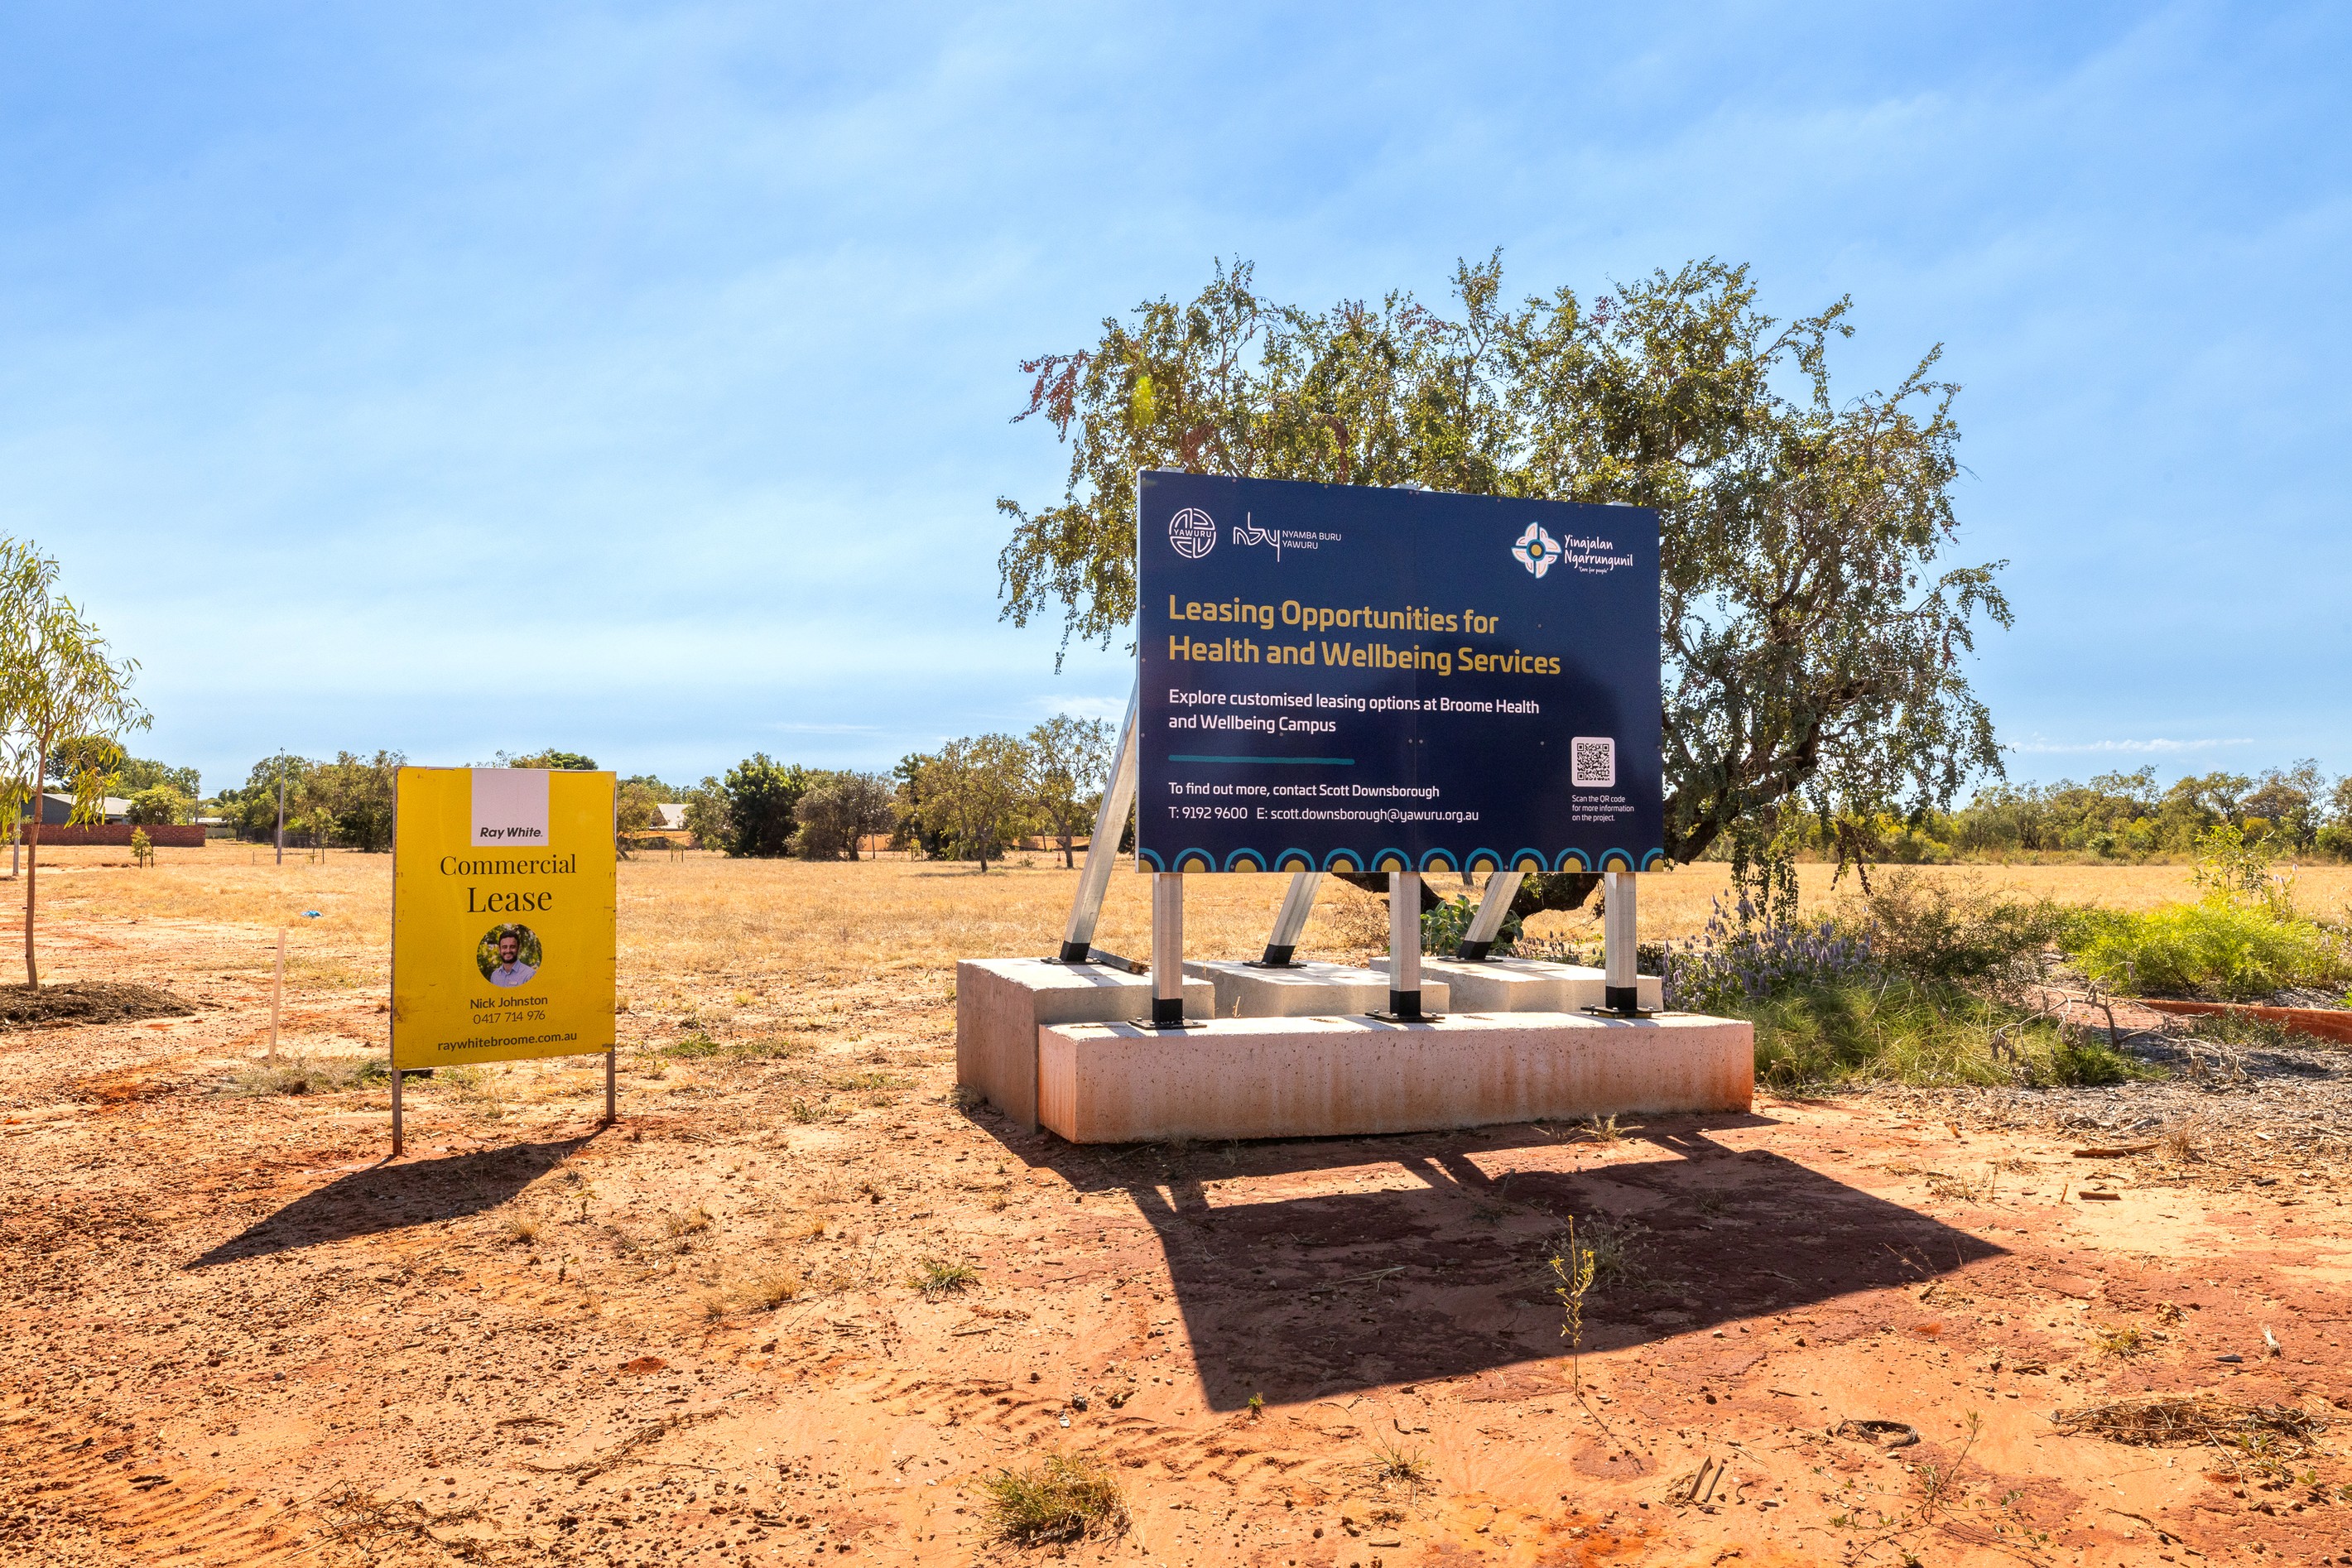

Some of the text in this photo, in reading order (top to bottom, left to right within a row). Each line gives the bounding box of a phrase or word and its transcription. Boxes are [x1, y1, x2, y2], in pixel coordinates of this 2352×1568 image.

[1174, 529, 1212, 538] YAWURU
[1282, 531, 1341, 541] NYAMBA BURU
[1282, 540, 1318, 549] YAWURU
[1565, 535, 1613, 555] Yinajalan
[1565, 549, 1633, 570] Ngarrungunil
[1170, 594, 1498, 633] Leasing Opportunities for
[1170, 636, 1561, 676] Health and Wellbeing Services
[1169, 689, 1540, 714] Explore customised leasing options at Broome Health
[1169, 714, 1336, 734] and Wellbeing Campus
[1169, 782, 1439, 800] To find out more, contact Scott Downsborough
[1169, 806, 1479, 823] T: 9192 9600 E: scott.downsborough@yawuru.org.au
[1593, 815, 1616, 823] project.
[480, 827, 505, 839] Ray
[440, 854, 576, 876] Commercial
[467, 887, 553, 912] Lease
[470, 995, 548, 1010] Nick Johnston
[474, 1010, 546, 1025] 0417 714 976
[437, 1032, 578, 1051] raywhitebroome.com.au
